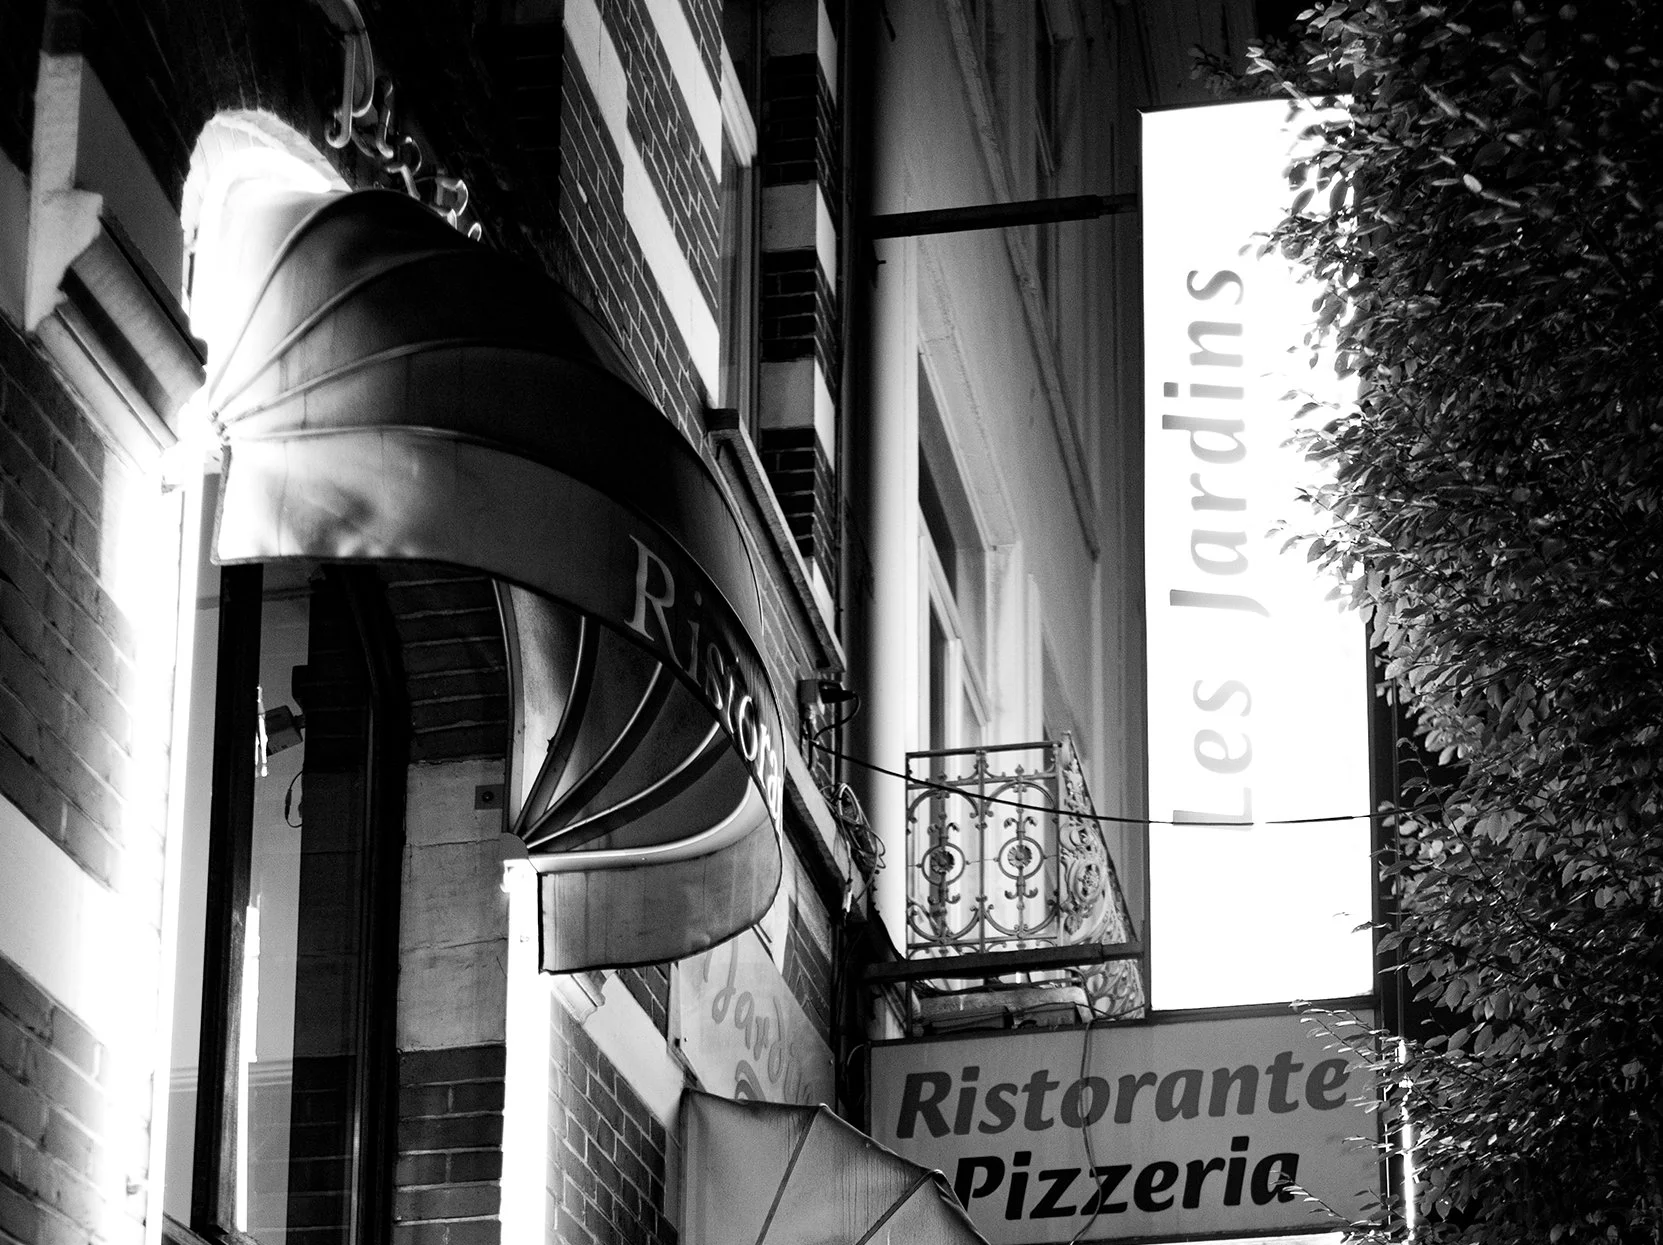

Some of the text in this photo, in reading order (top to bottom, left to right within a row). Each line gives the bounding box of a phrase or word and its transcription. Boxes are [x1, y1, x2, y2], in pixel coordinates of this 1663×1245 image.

[1162, 269, 1271, 831] Les Jardins
[896, 1051, 1351, 1139] Ristorante
[954, 1135, 1301, 1221] Pizzeria
